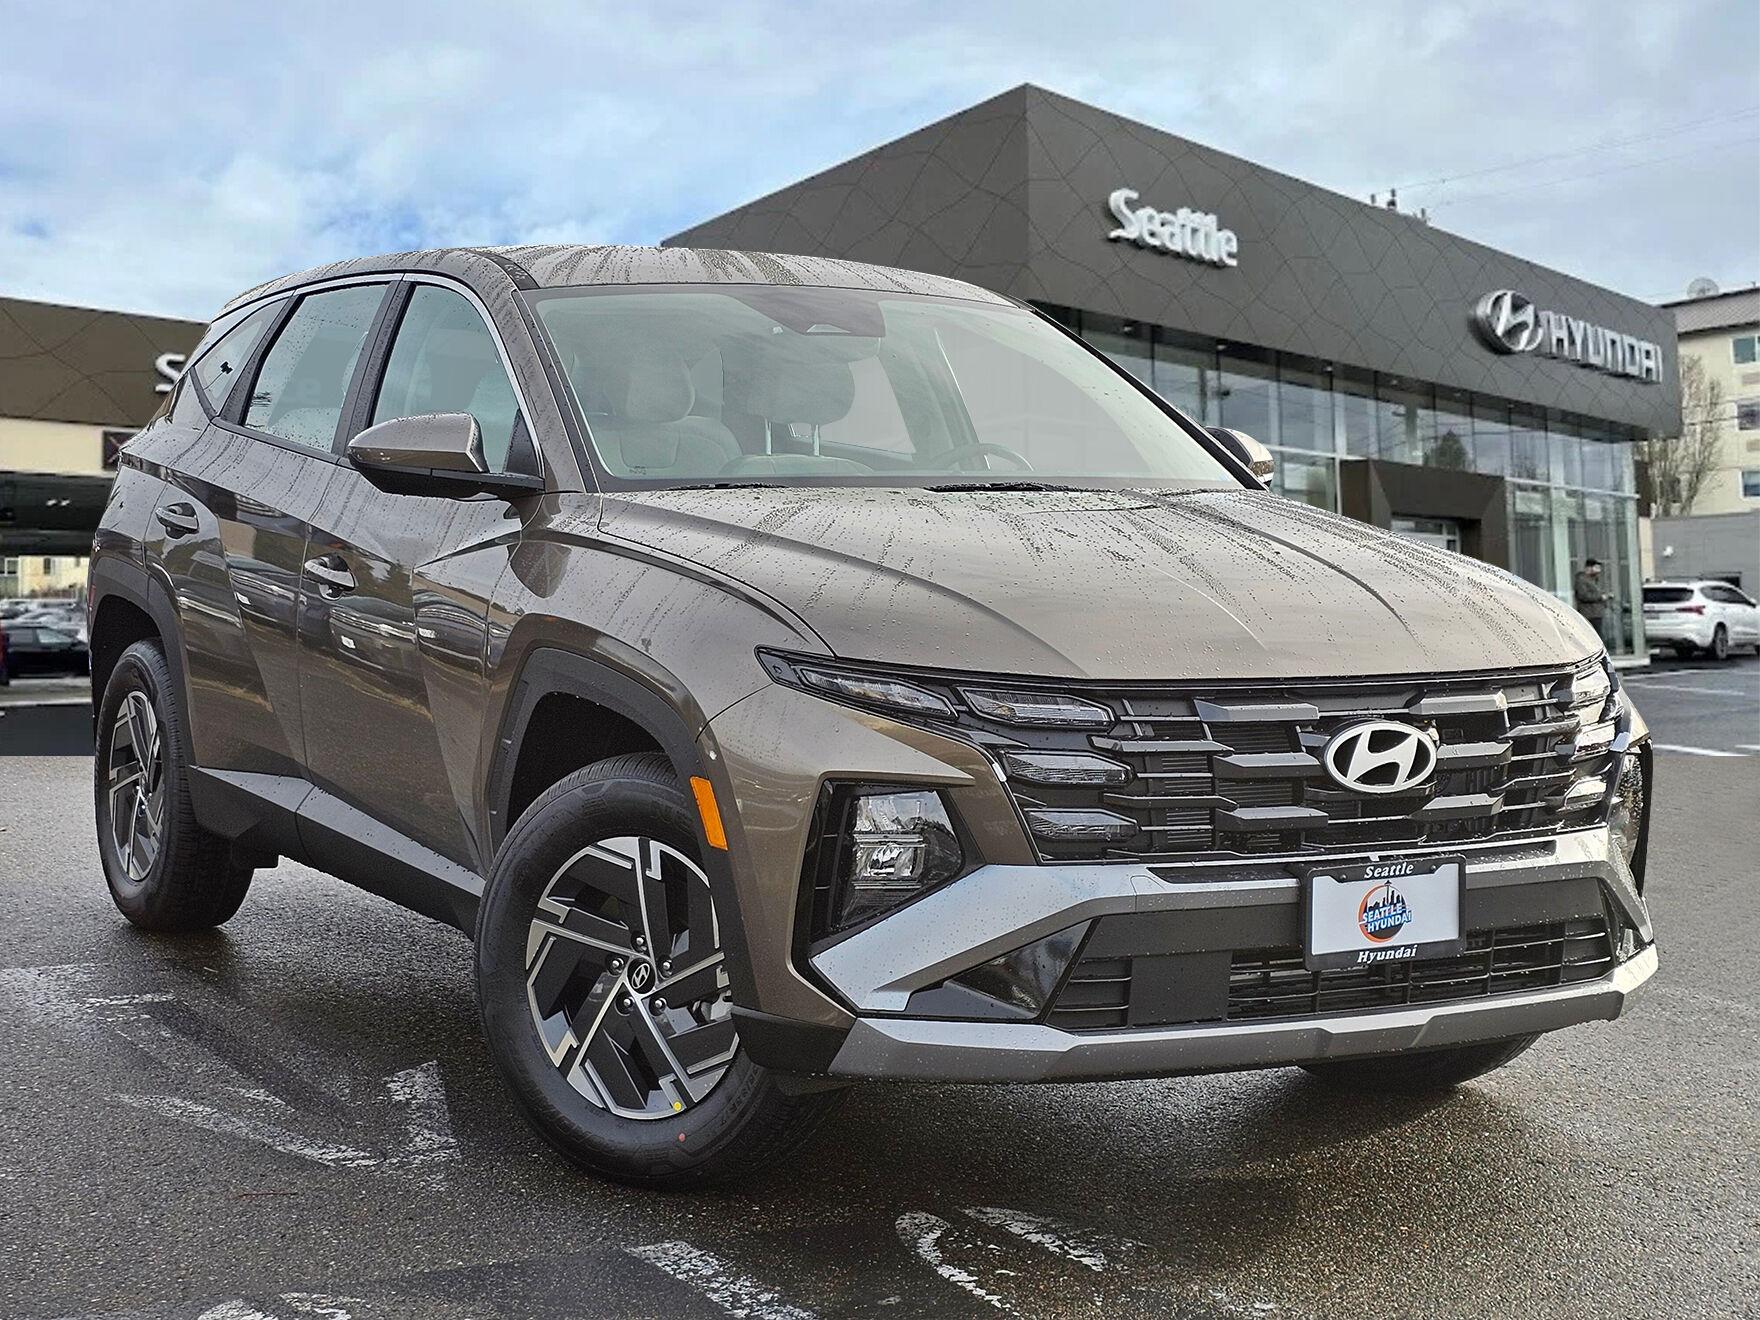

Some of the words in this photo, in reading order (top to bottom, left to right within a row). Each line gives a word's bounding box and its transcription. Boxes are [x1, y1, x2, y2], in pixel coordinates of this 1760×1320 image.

[1108, 187, 1238, 266] Seattle
[1540, 311, 1663, 384] HYUNDAI
[1364, 863, 1414, 878] Seattle
[1362, 902, 1404, 924] SEATTLE
[1367, 911, 1411, 932] HYUNDAI
[1357, 946, 1417, 963] Hyundai
